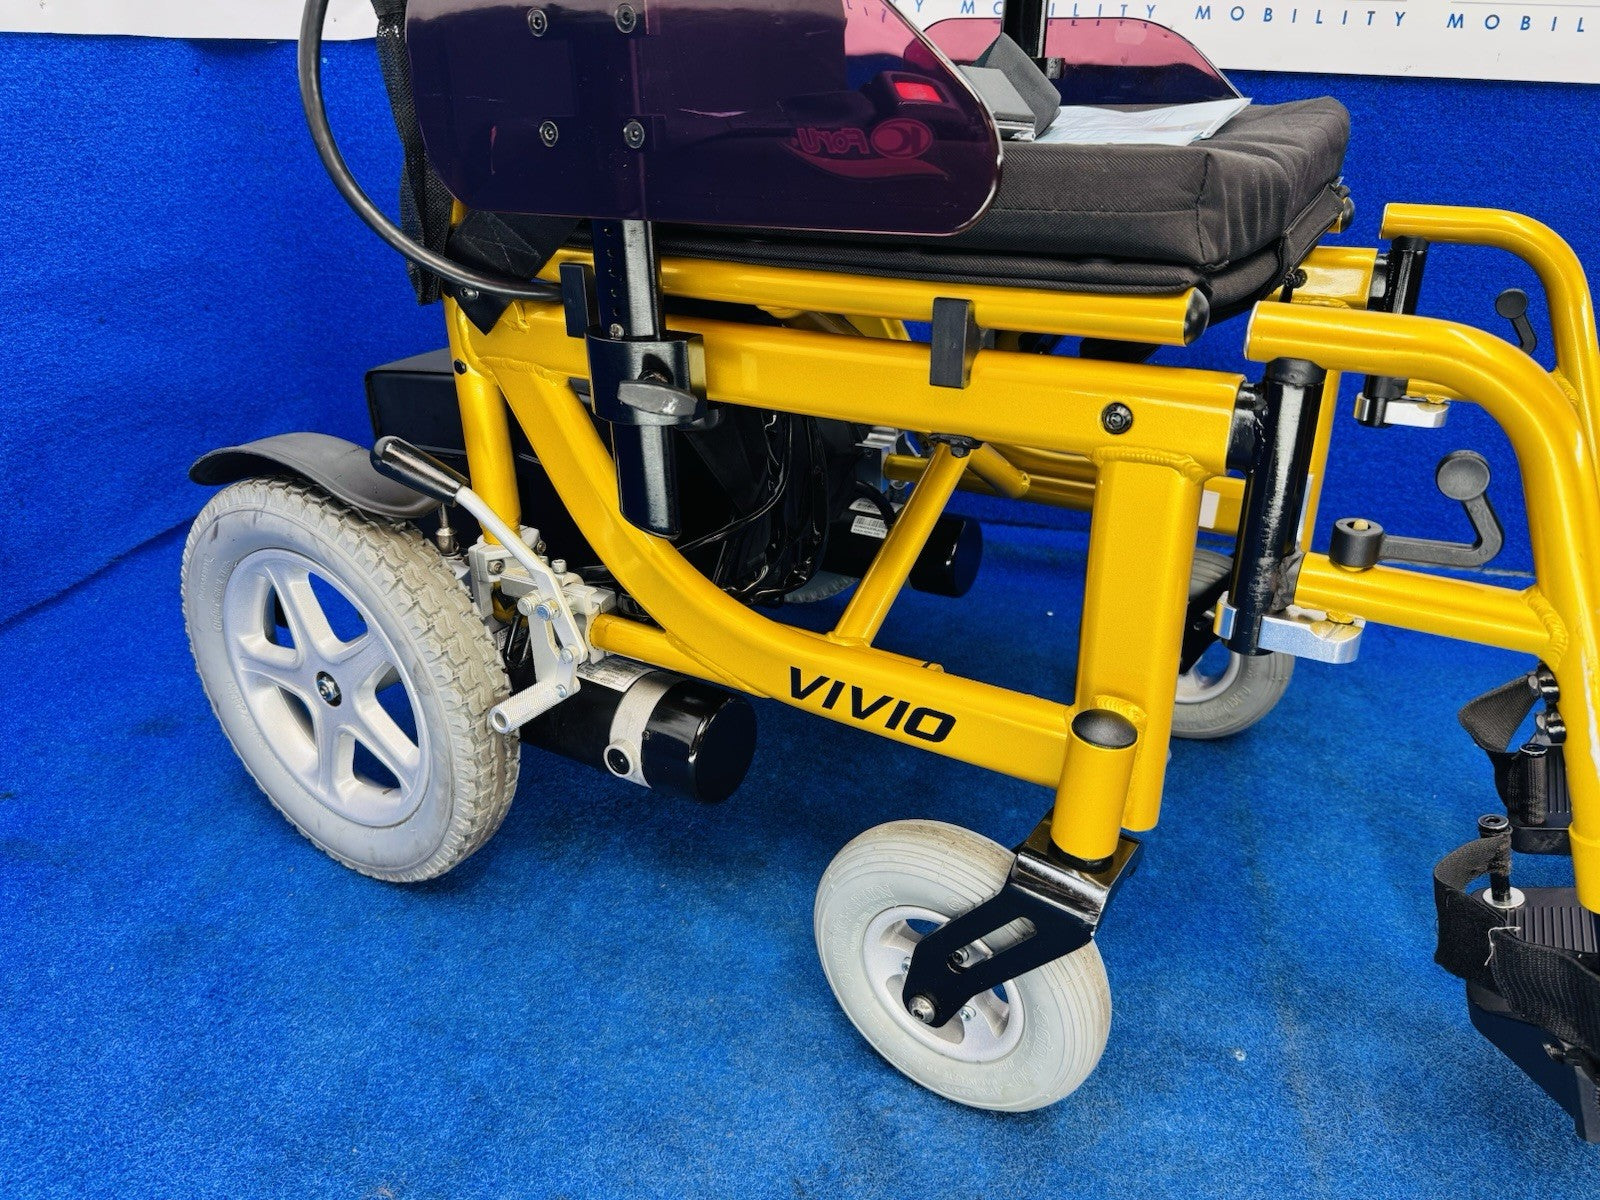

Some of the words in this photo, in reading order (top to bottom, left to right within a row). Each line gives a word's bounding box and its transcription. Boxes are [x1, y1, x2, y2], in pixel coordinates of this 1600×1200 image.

[960, 2, 1156, 17] MOILITY
[1195, 5, 1406, 27] MOBILITY
[1447, 13, 1585, 33] MOBIL
[790, 666, 957, 743] VIVIO
